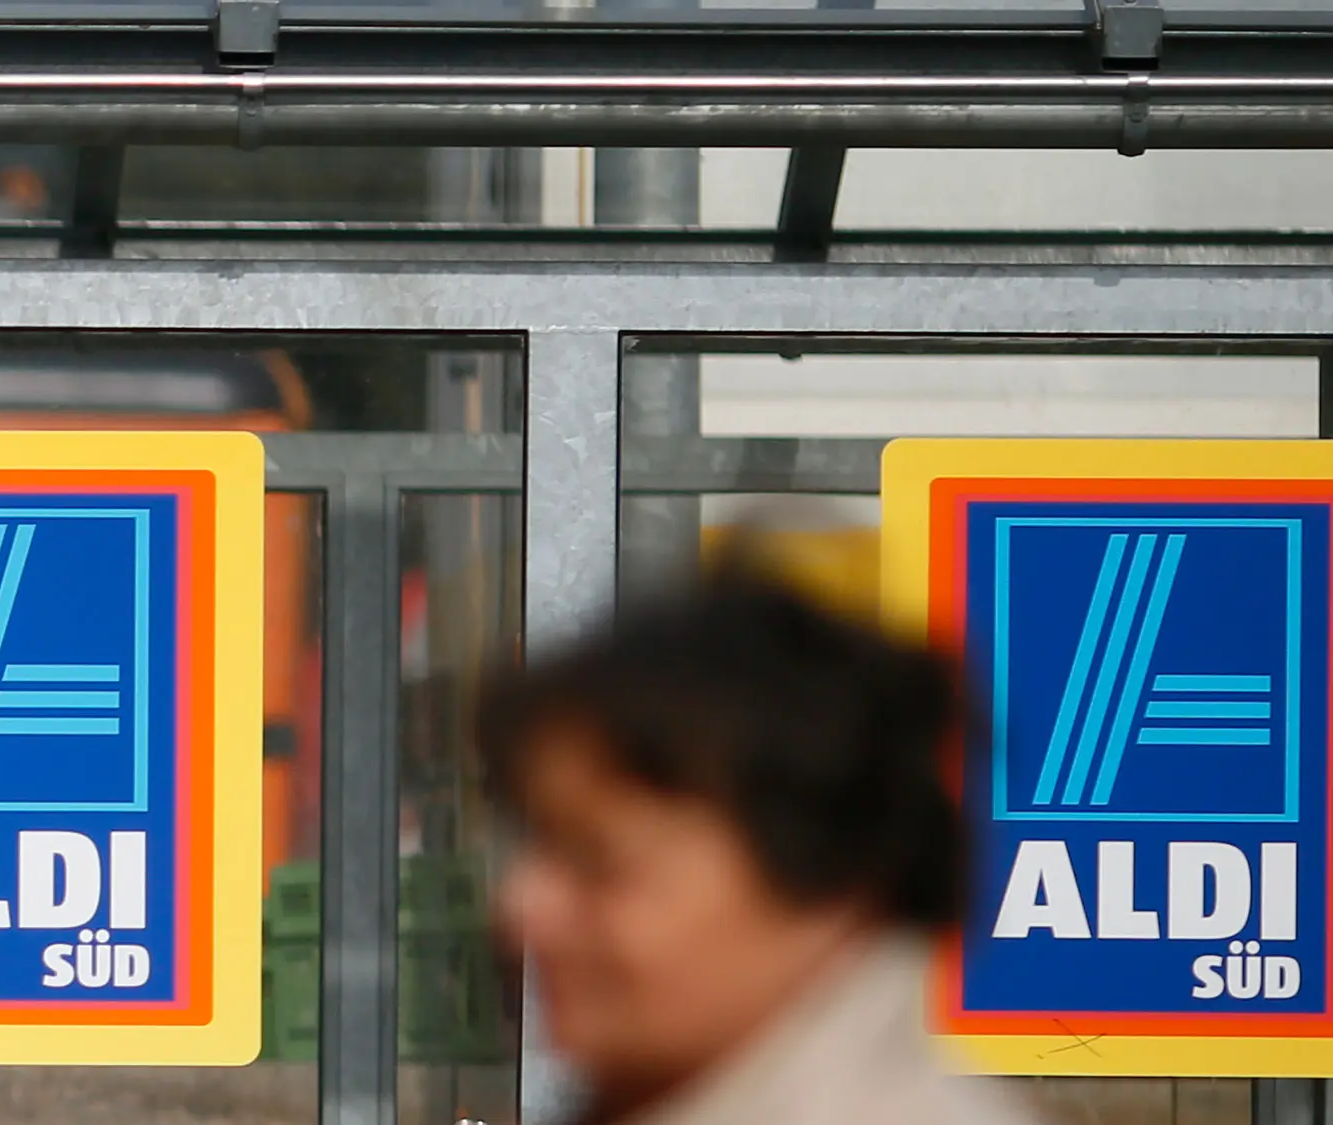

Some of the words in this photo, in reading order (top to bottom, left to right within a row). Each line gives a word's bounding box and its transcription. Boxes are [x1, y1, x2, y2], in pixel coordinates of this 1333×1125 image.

[991, 840, 1297, 941] ALDI
[41, 929, 150, 988] SÜD
[1192, 940, 1300, 999] SÜD
